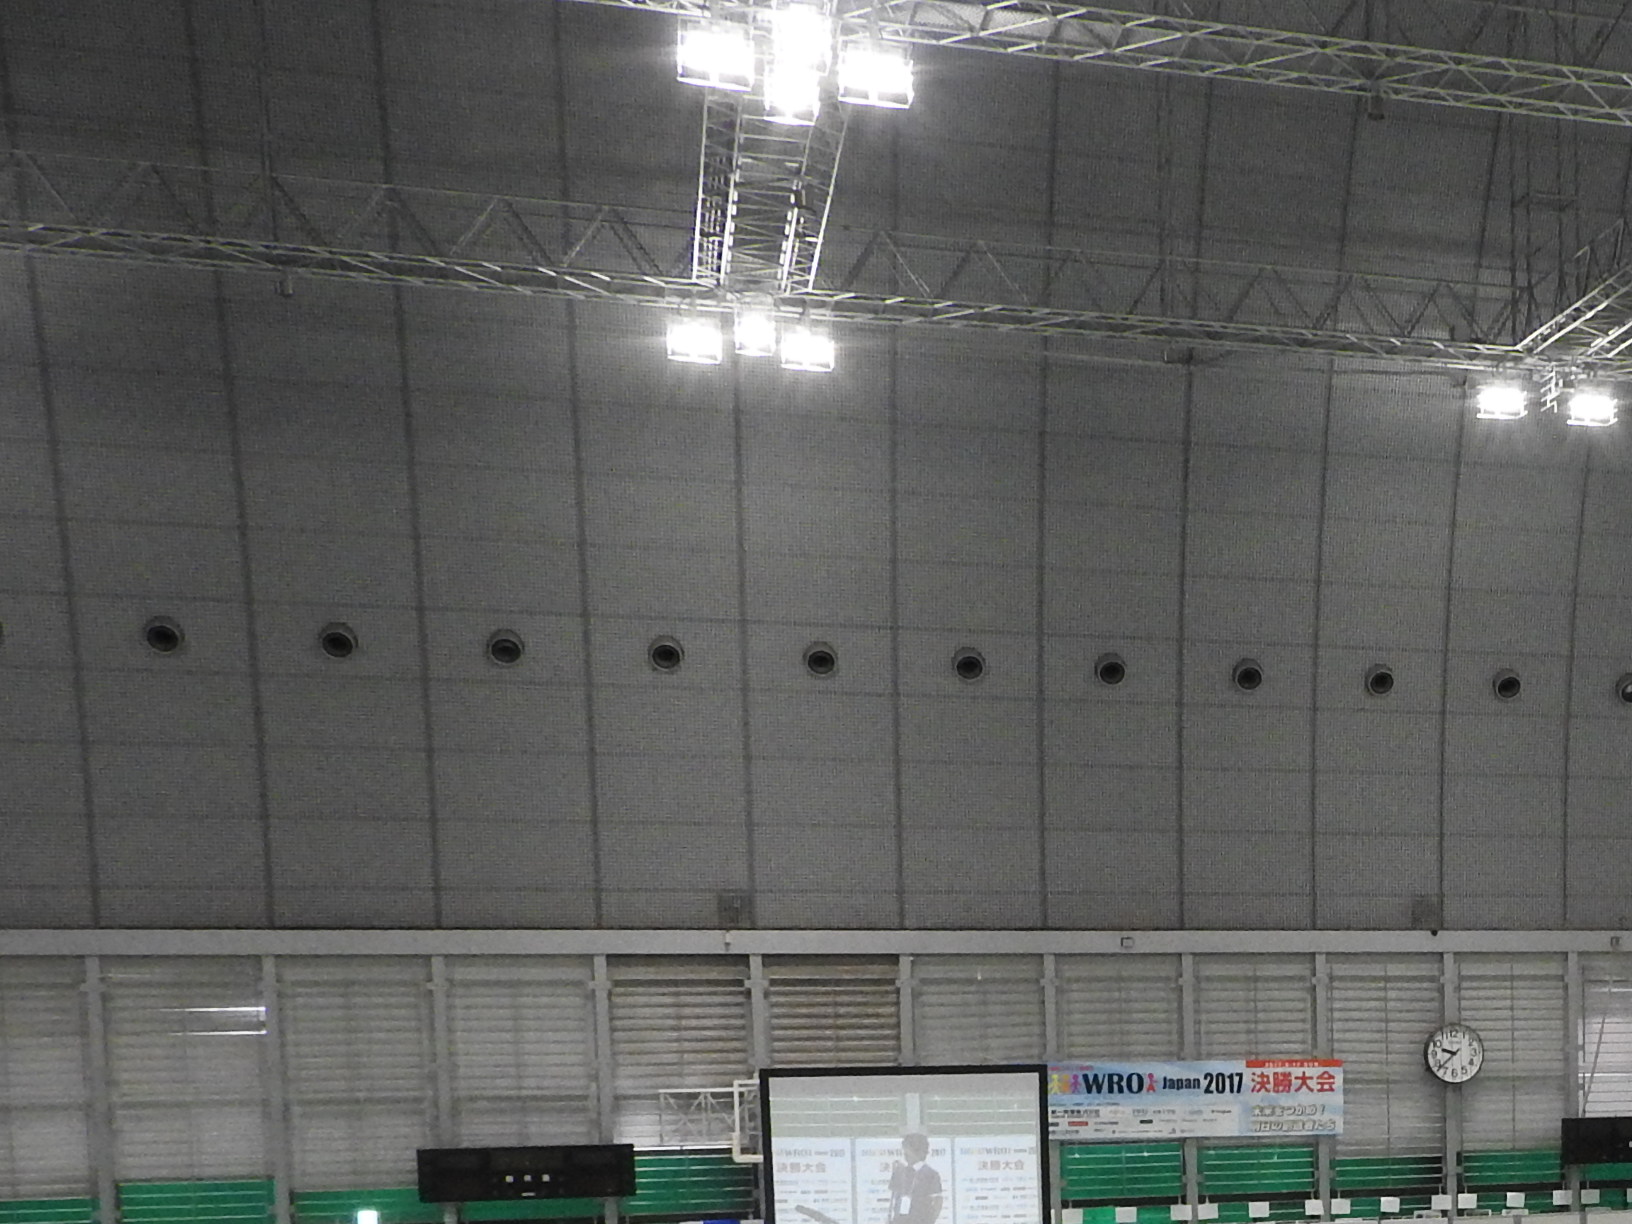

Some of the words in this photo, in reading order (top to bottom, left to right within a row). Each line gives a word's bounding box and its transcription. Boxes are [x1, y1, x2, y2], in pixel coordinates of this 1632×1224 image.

[1081, 1072, 1145, 1095] WRO
[1162, 1075, 1200, 1091] Japan
[1203, 1072, 1244, 1095] 2017
[1250, 1071, 1336, 1094] 決勝大会
